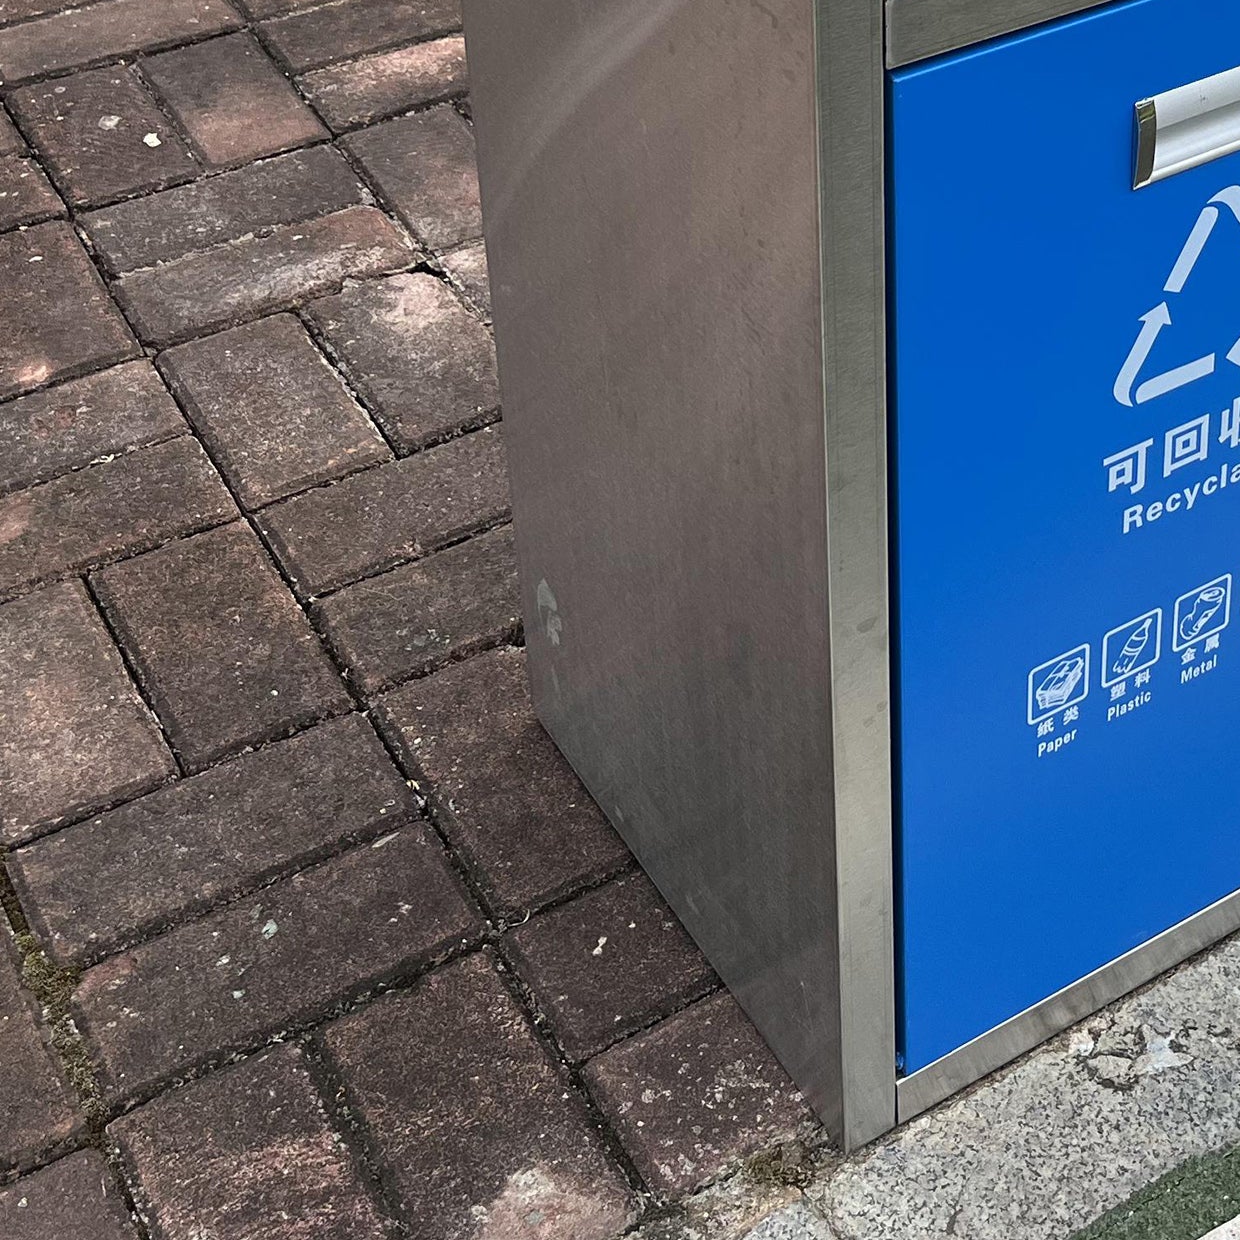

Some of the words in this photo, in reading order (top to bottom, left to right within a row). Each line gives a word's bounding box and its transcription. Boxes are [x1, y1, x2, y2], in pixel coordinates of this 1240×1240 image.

[1180, 654, 1217, 684] Metal
[1110, 669, 1151, 701] 塑料
[1107, 691, 1152, 721] Plastic
[1037, 728, 1078, 757] Paper
